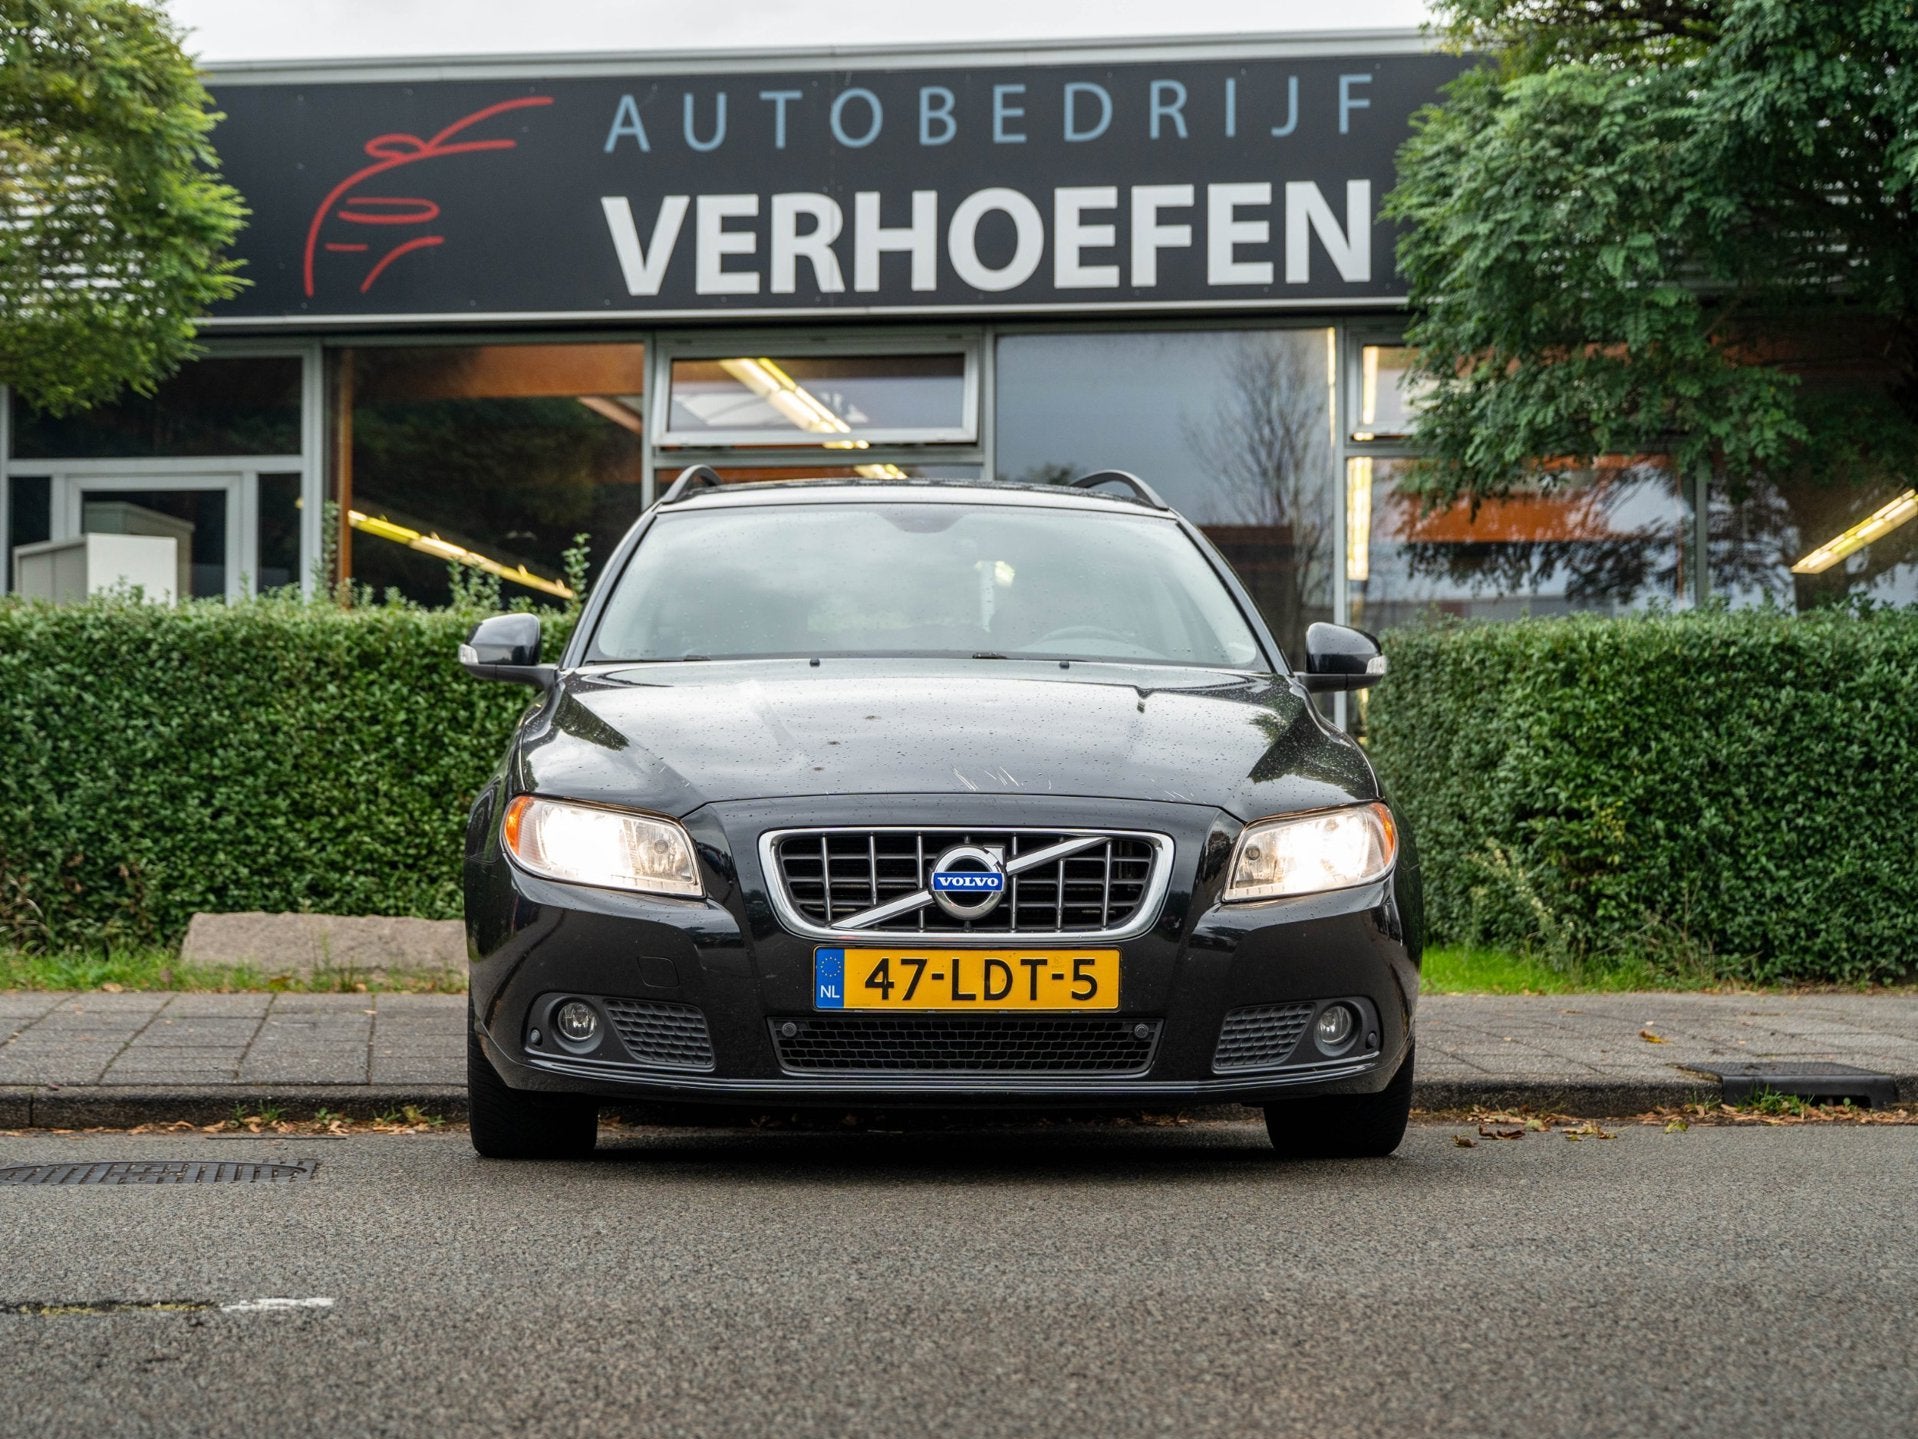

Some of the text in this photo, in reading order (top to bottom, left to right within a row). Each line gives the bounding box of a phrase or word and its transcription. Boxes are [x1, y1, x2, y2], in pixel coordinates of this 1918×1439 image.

[603, 74, 1373, 153] AUTOBEDRIJF
[602, 179, 1371, 296] VERHOEFEN
[937, 876, 999, 887] VOLVO
[820, 984, 841, 999] NL
[864, 957, 1098, 1001] 47-LDT-5
